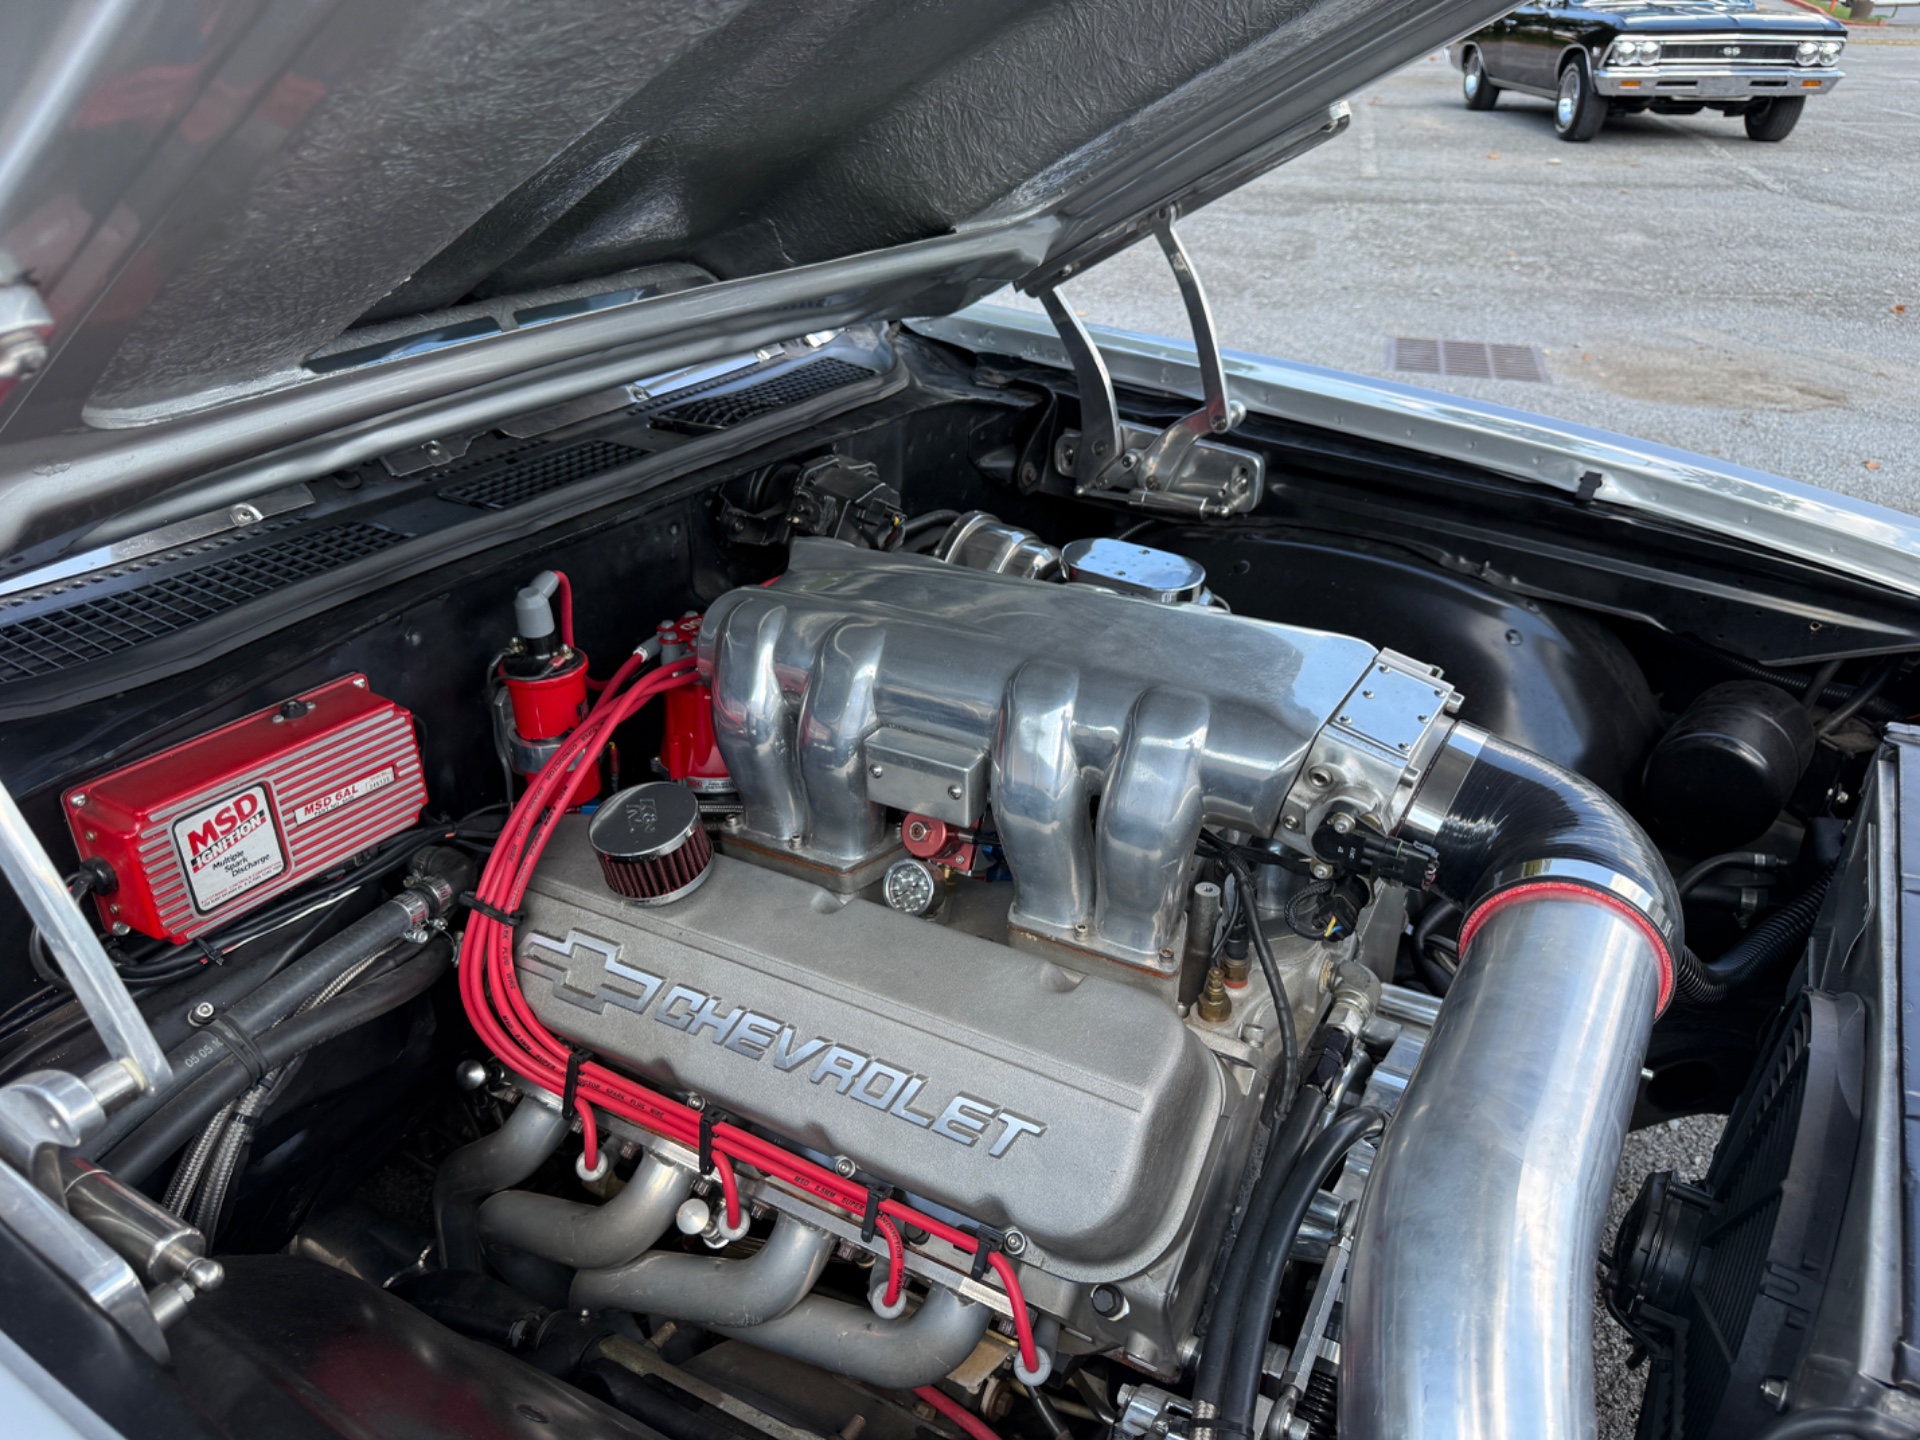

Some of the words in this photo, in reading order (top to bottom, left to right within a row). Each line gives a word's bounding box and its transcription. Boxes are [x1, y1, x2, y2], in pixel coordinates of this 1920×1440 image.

[304, 796, 333, 817] MSD
[335, 785, 359, 802] 6AL
[187, 793, 259, 857] MSD
[196, 812, 262, 869] IGNITION
[213, 850, 245, 871] Multiple
[224, 857, 249, 873] Spark
[232, 854, 271, 878] Discharge
[502, 945, 511, 966] PLUG
[185, 1053, 200, 1068] 05
[198, 1044, 214, 1059] 05
[654, 984, 1048, 1159] CHEVROLET
[535, 1053, 557, 1071] SUPER
[605, 1087, 626, 1101] SPARK
[630, 1098, 646, 1110] PLUG
[650, 1108, 665, 1119] WIRE
[793, 1175, 810, 1187] MSD
[841, 1196, 866, 1212] SUPER
[896, 1268, 904, 1296] SPARK
